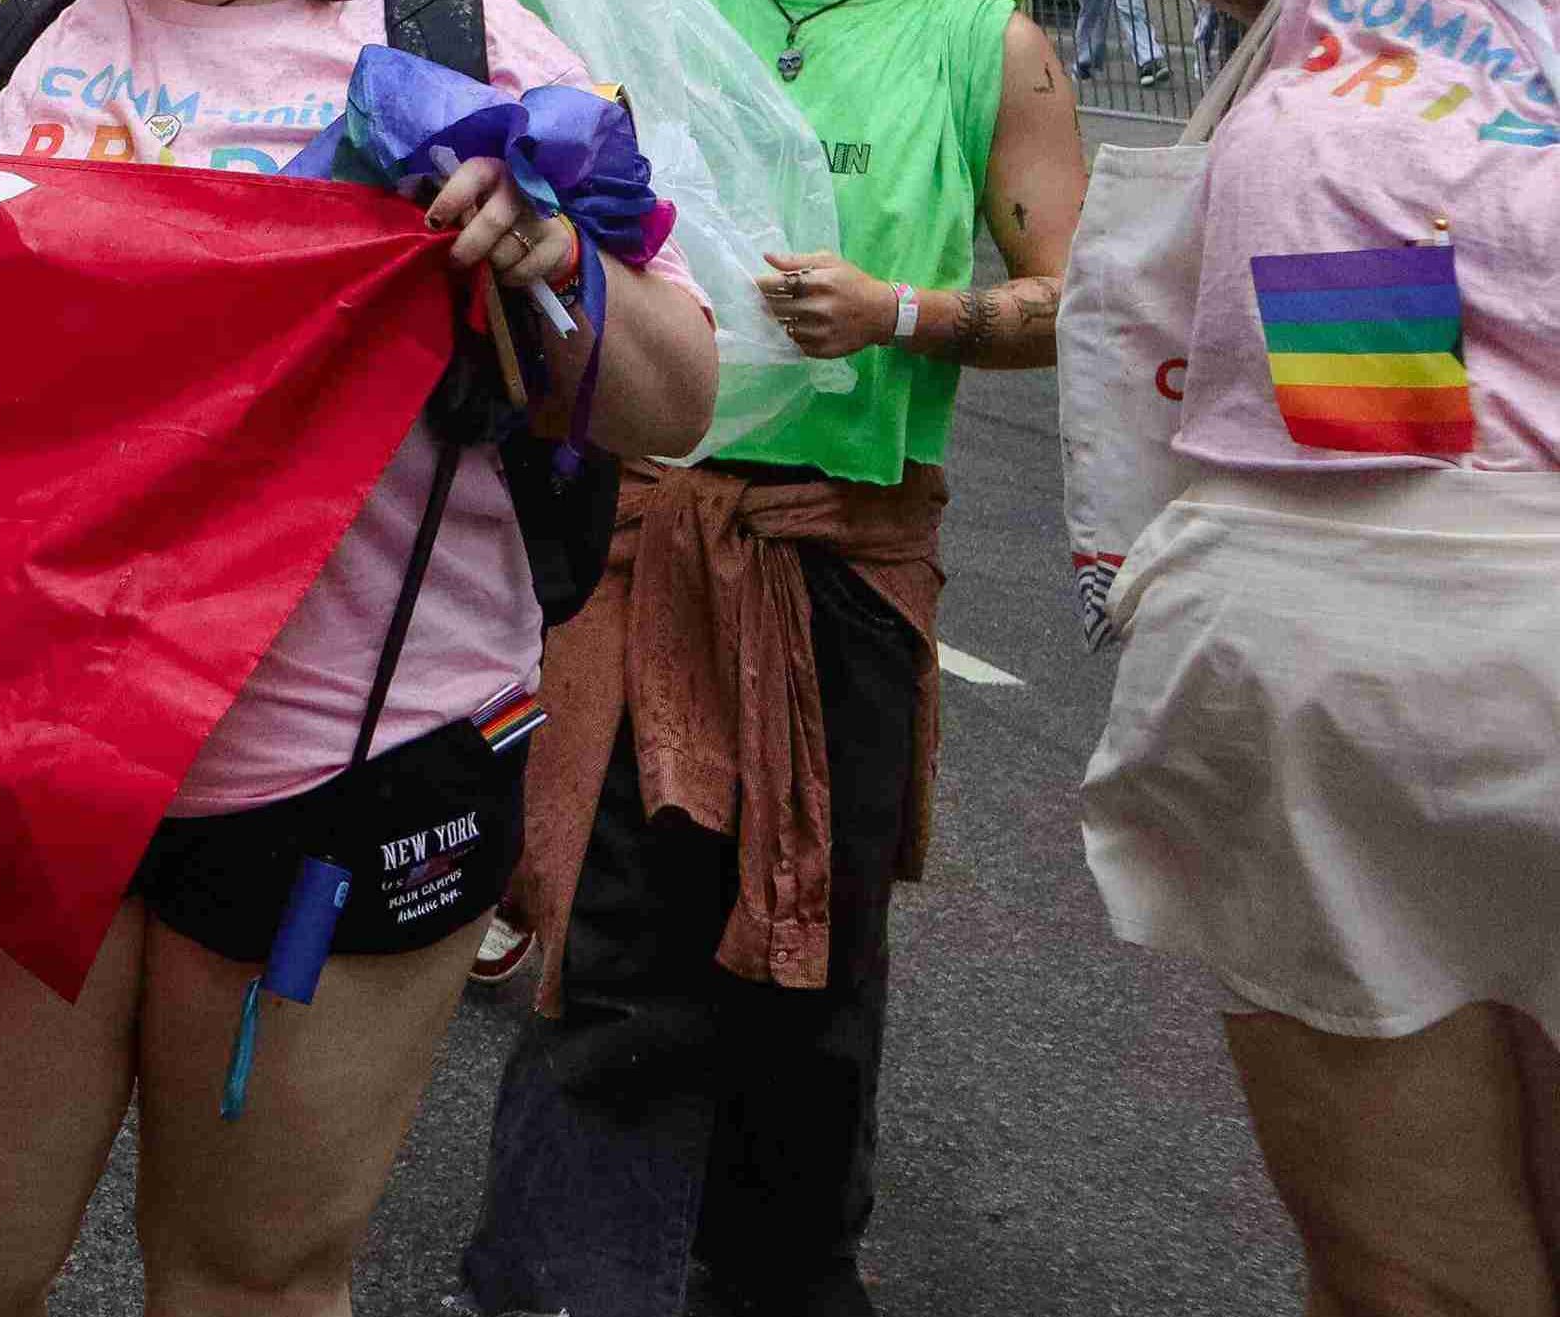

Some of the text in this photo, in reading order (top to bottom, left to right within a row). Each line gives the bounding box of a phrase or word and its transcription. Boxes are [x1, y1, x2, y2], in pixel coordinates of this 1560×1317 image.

[380, 810, 480, 870] NEW YORK
[421, 867, 463, 895] CAMPUS
